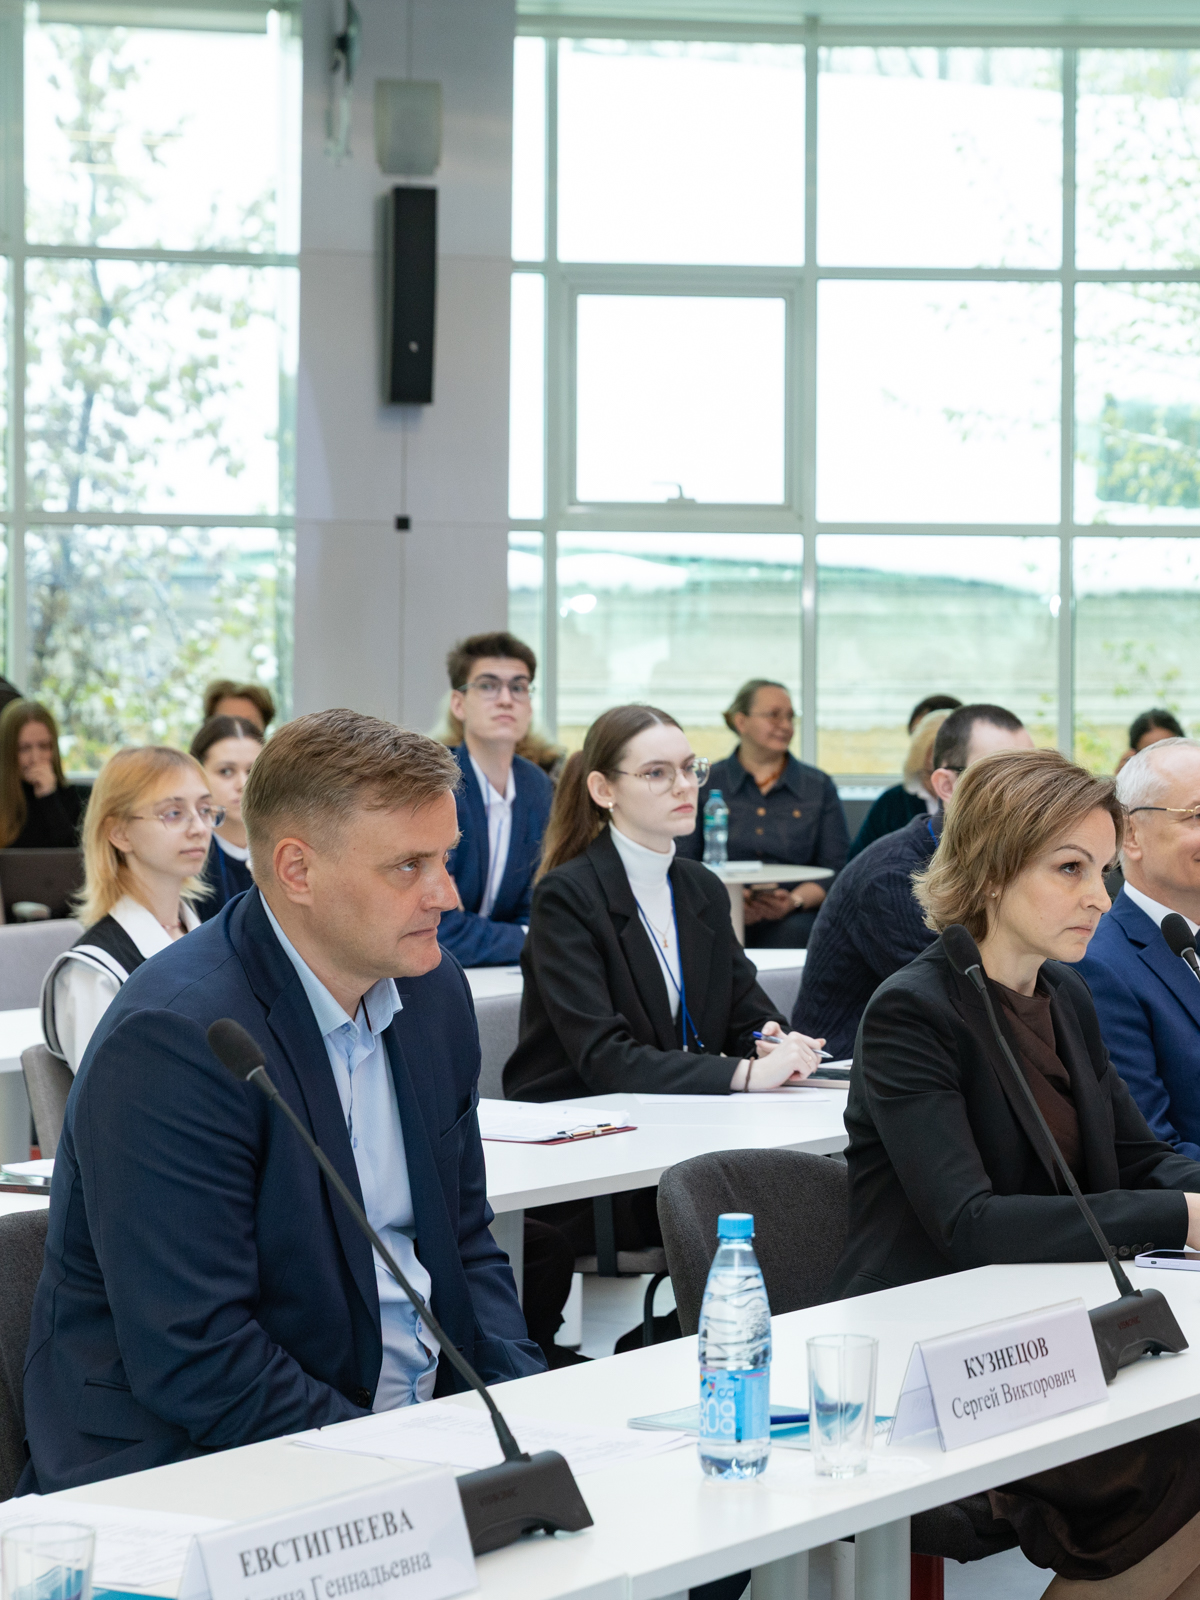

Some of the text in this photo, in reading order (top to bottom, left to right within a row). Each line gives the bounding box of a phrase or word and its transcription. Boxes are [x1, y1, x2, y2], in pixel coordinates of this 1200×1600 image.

[963, 1336, 1049, 1380] КУЗНЕЦОВ
[951, 1368, 1077, 1421] Сергей Викторович
[237, 1507, 414, 1578] ЕВСТИГНЕЕВА
[311, 1551, 433, 1600] Геннадьевна
